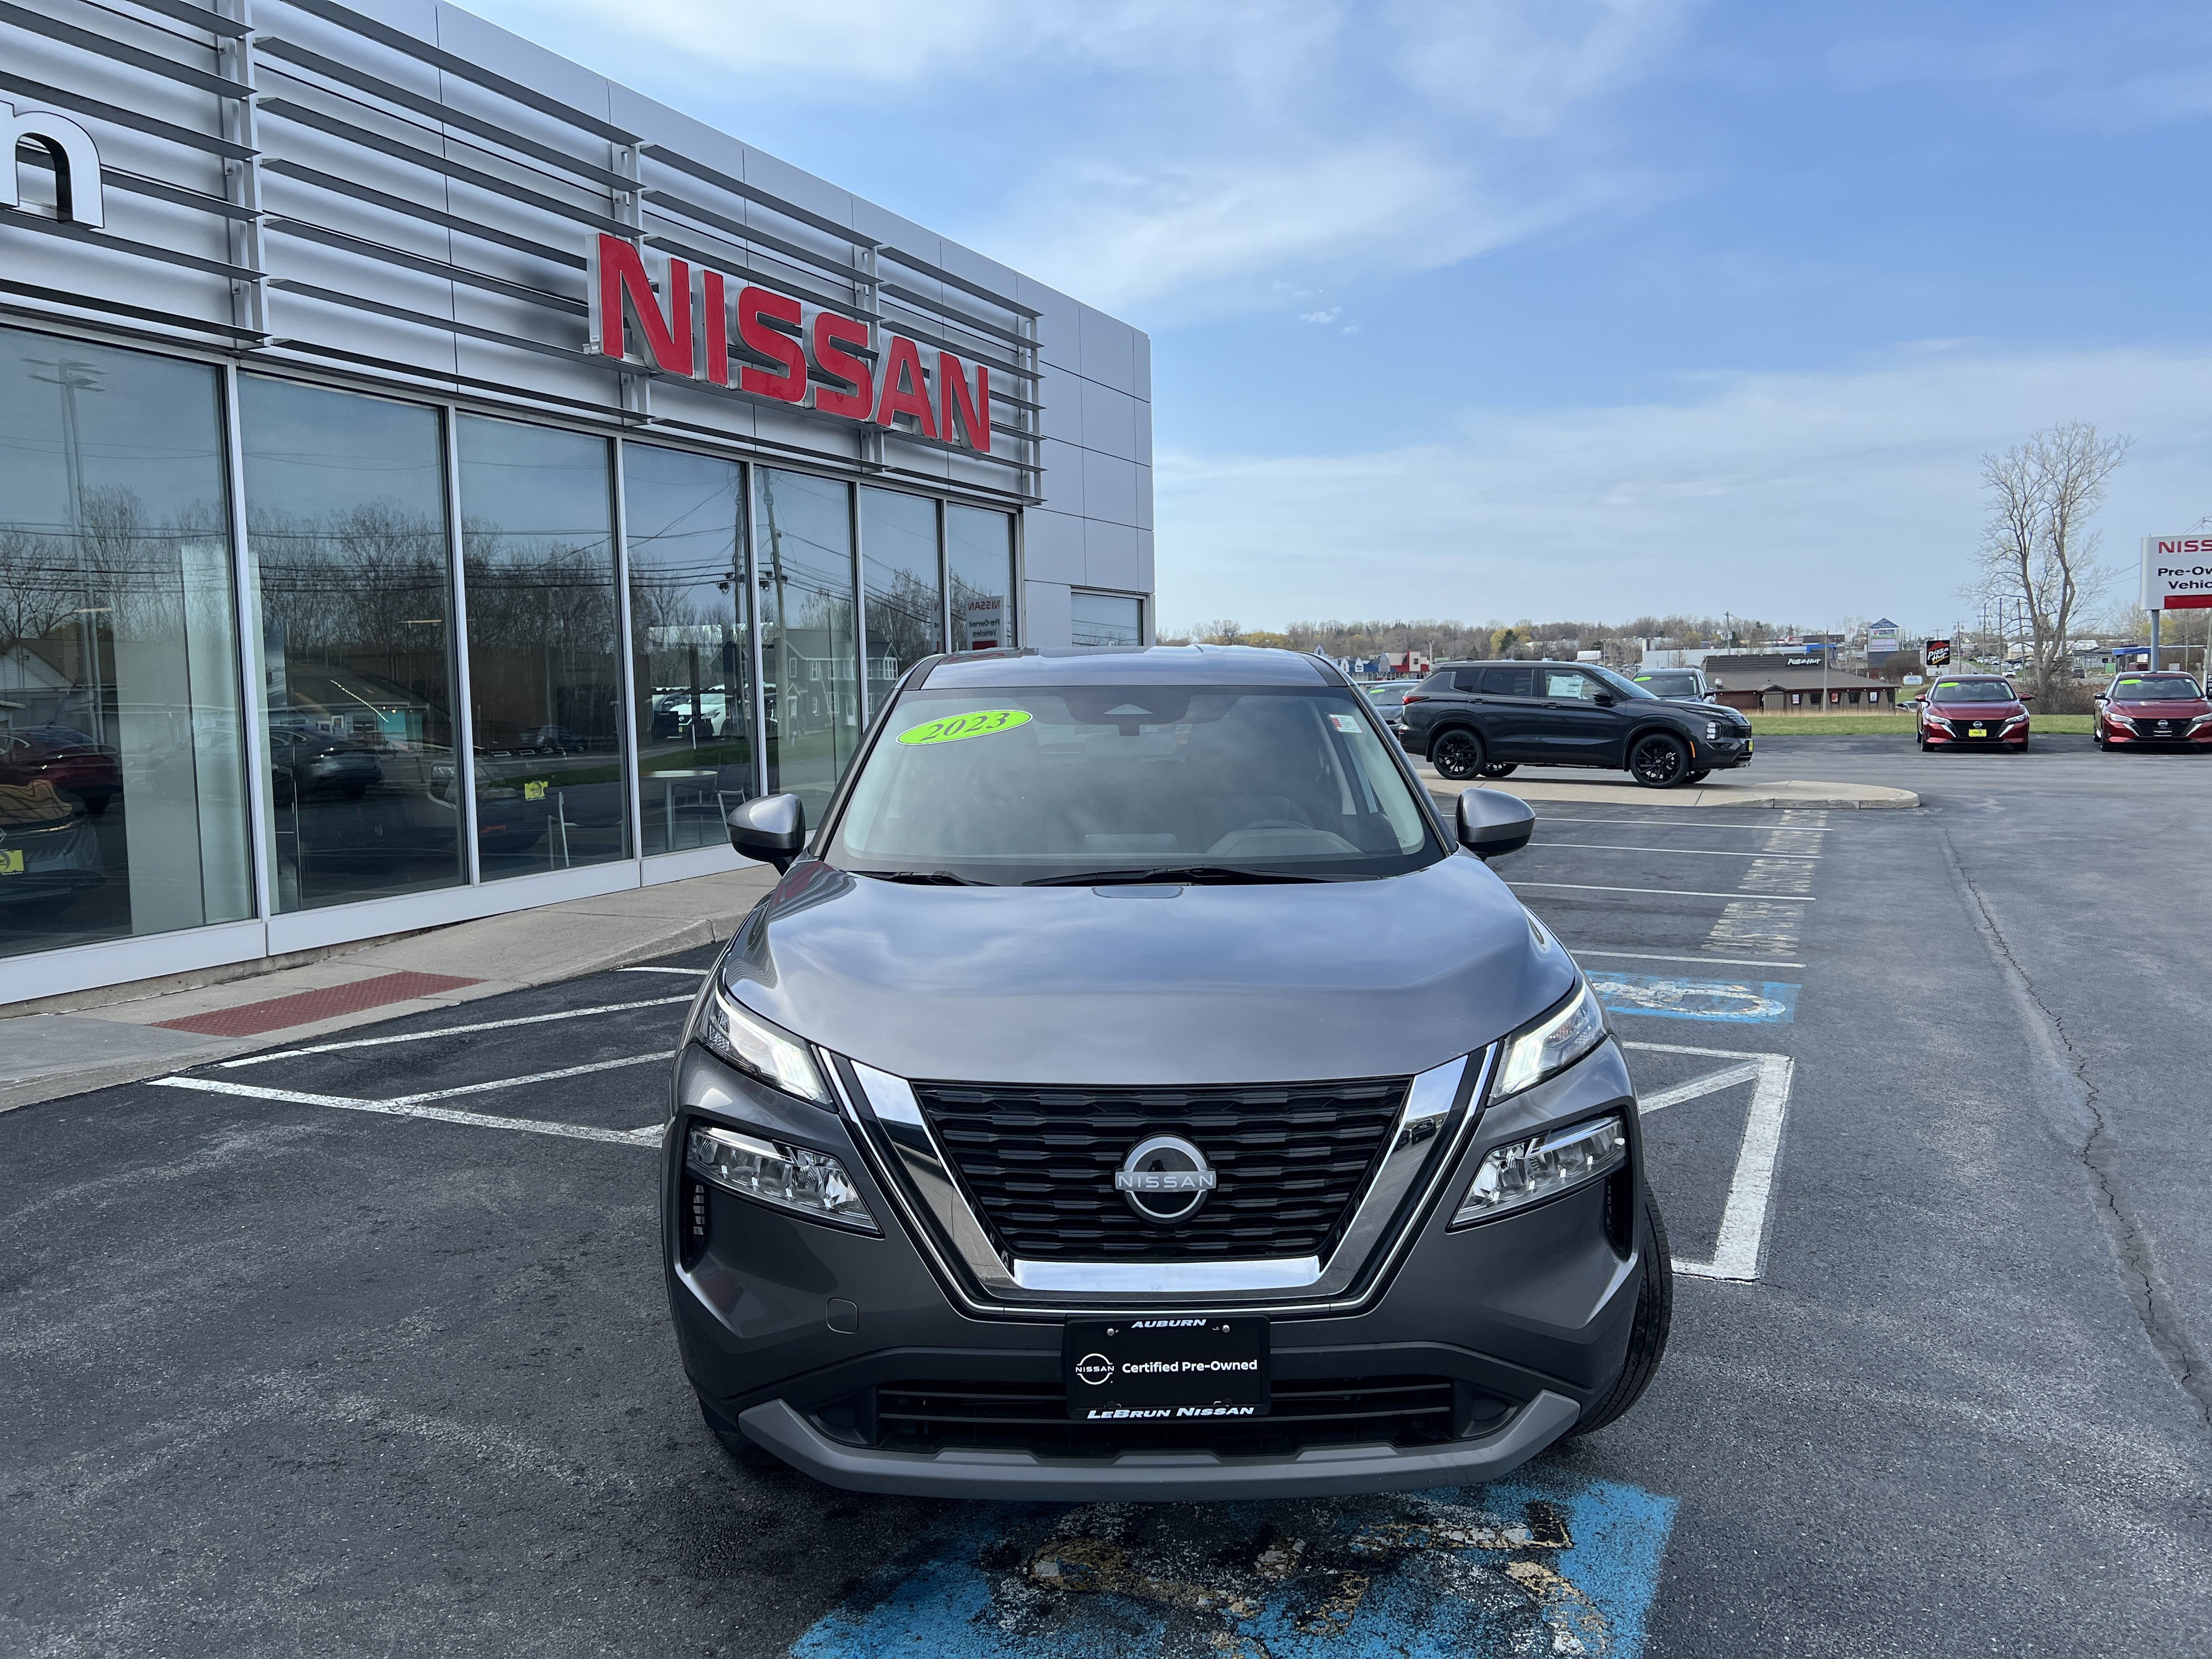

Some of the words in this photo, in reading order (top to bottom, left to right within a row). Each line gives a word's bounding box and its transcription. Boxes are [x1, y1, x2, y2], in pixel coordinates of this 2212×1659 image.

[598, 232, 990, 453] NISSAN
[1927, 647, 1949, 661] Pizza
[1932, 652, 1948, 662] Hut
[919, 713, 1010, 741] 2023
[1118, 1174, 1213, 1188] NISSAN
[1131, 1319, 1206, 1328] AUBURN
[1122, 1361, 1179, 1373] Certified
[1182, 1359, 1257, 1372] Pre-Owned
[1176, 1407, 1254, 1417] NISSAN
